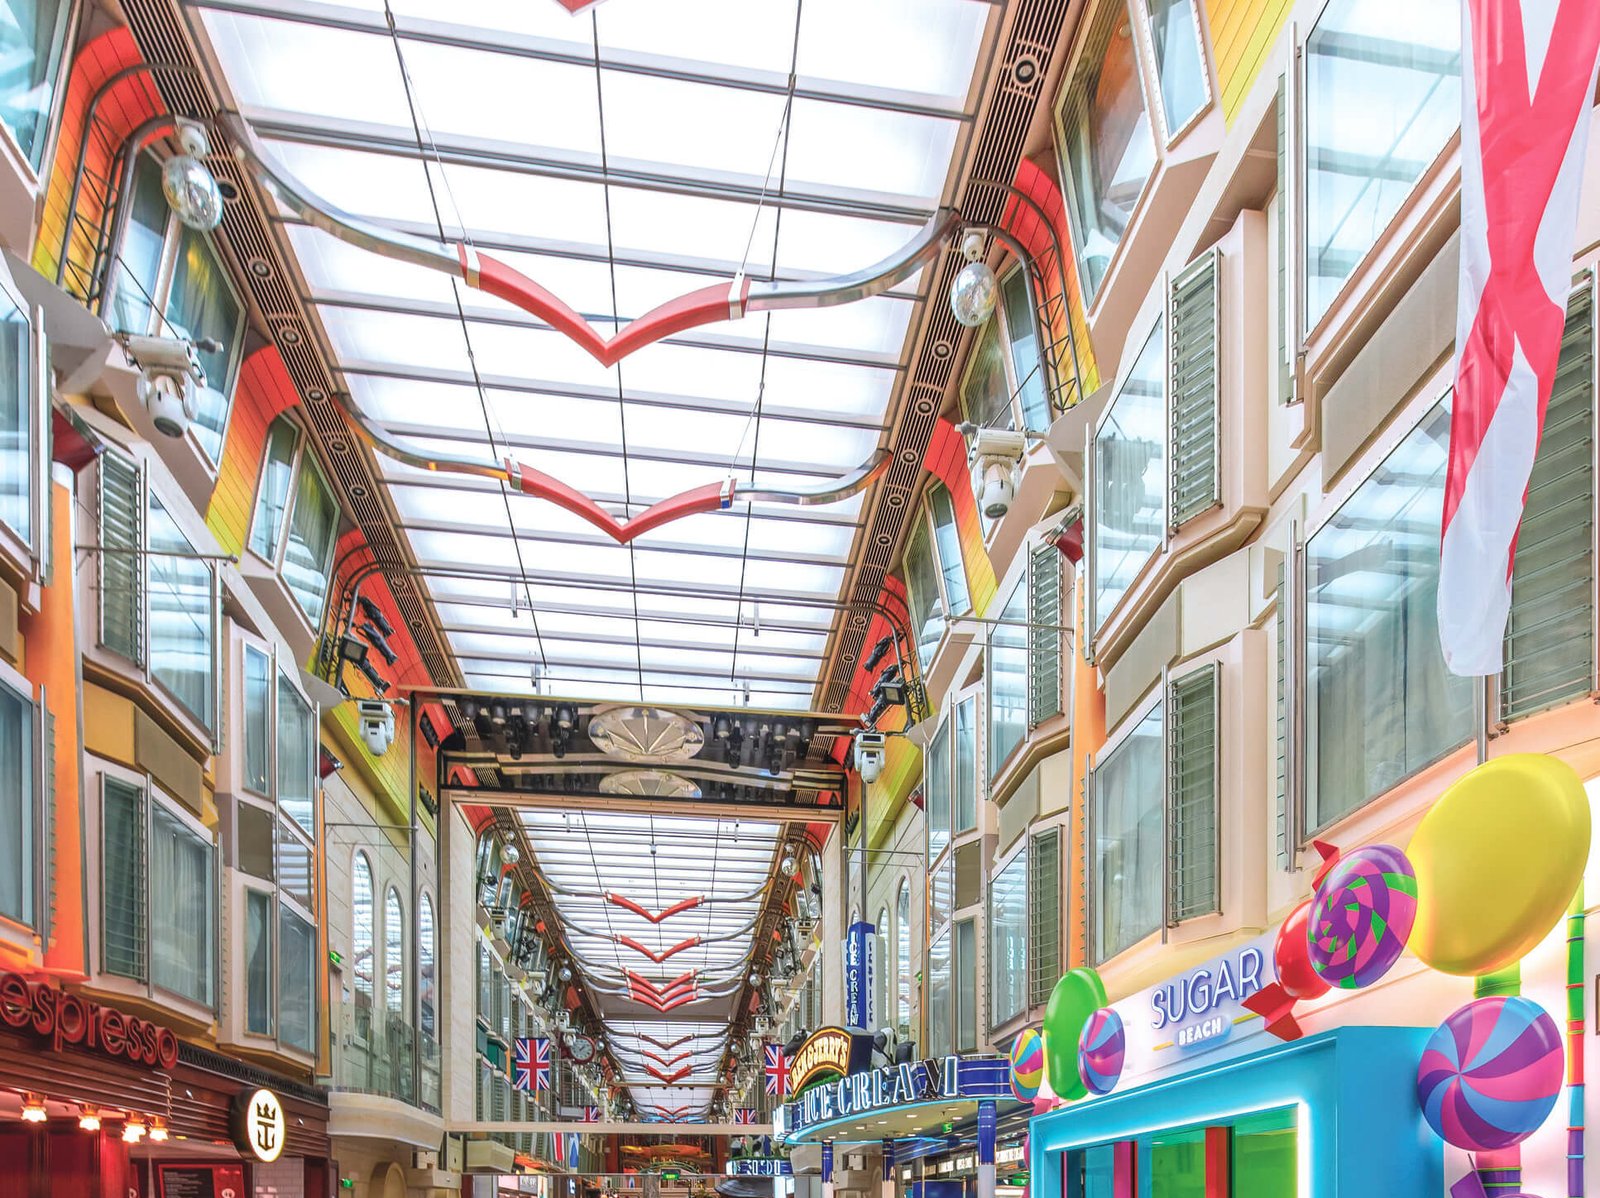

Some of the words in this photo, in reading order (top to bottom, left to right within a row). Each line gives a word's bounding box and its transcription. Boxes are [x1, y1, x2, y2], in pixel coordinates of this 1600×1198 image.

[849, 931, 860, 966] ICE
[849, 969, 860, 1026] CREAM
[1151, 948, 1264, 1030] SUGAR
[0, 972, 178, 1070] espresso
[1178, 1016, 1222, 1046] BEACH
[804, 1083, 833, 1124] ICE
[837, 1055, 959, 1116] CREAM
